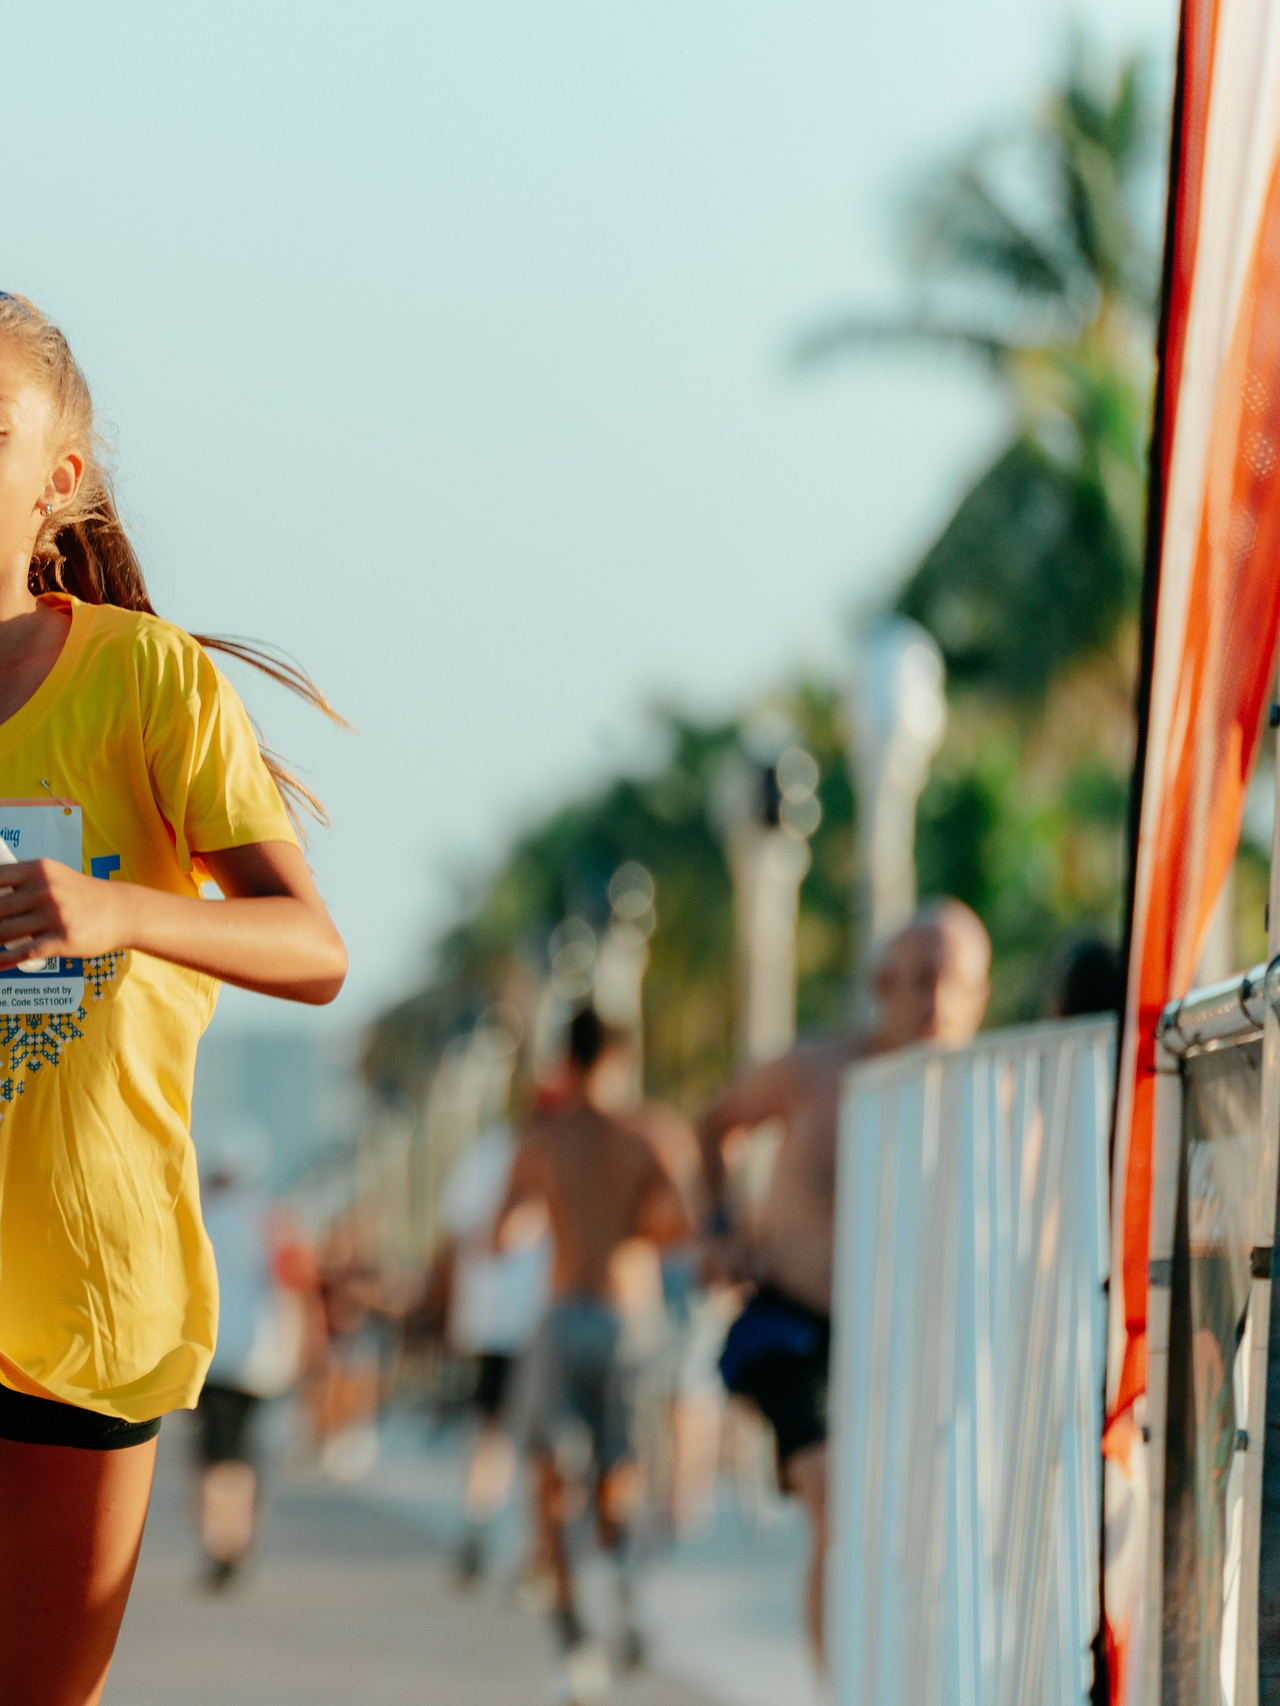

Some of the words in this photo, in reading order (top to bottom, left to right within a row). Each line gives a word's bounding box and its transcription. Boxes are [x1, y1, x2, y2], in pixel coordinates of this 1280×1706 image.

[1, 986, 13, 995] off
[14, 987, 41, 995] events
[42, 986, 60, 994] shot
[61, 986, 72, 995] by
[11, 998, 32, 1007] Code
